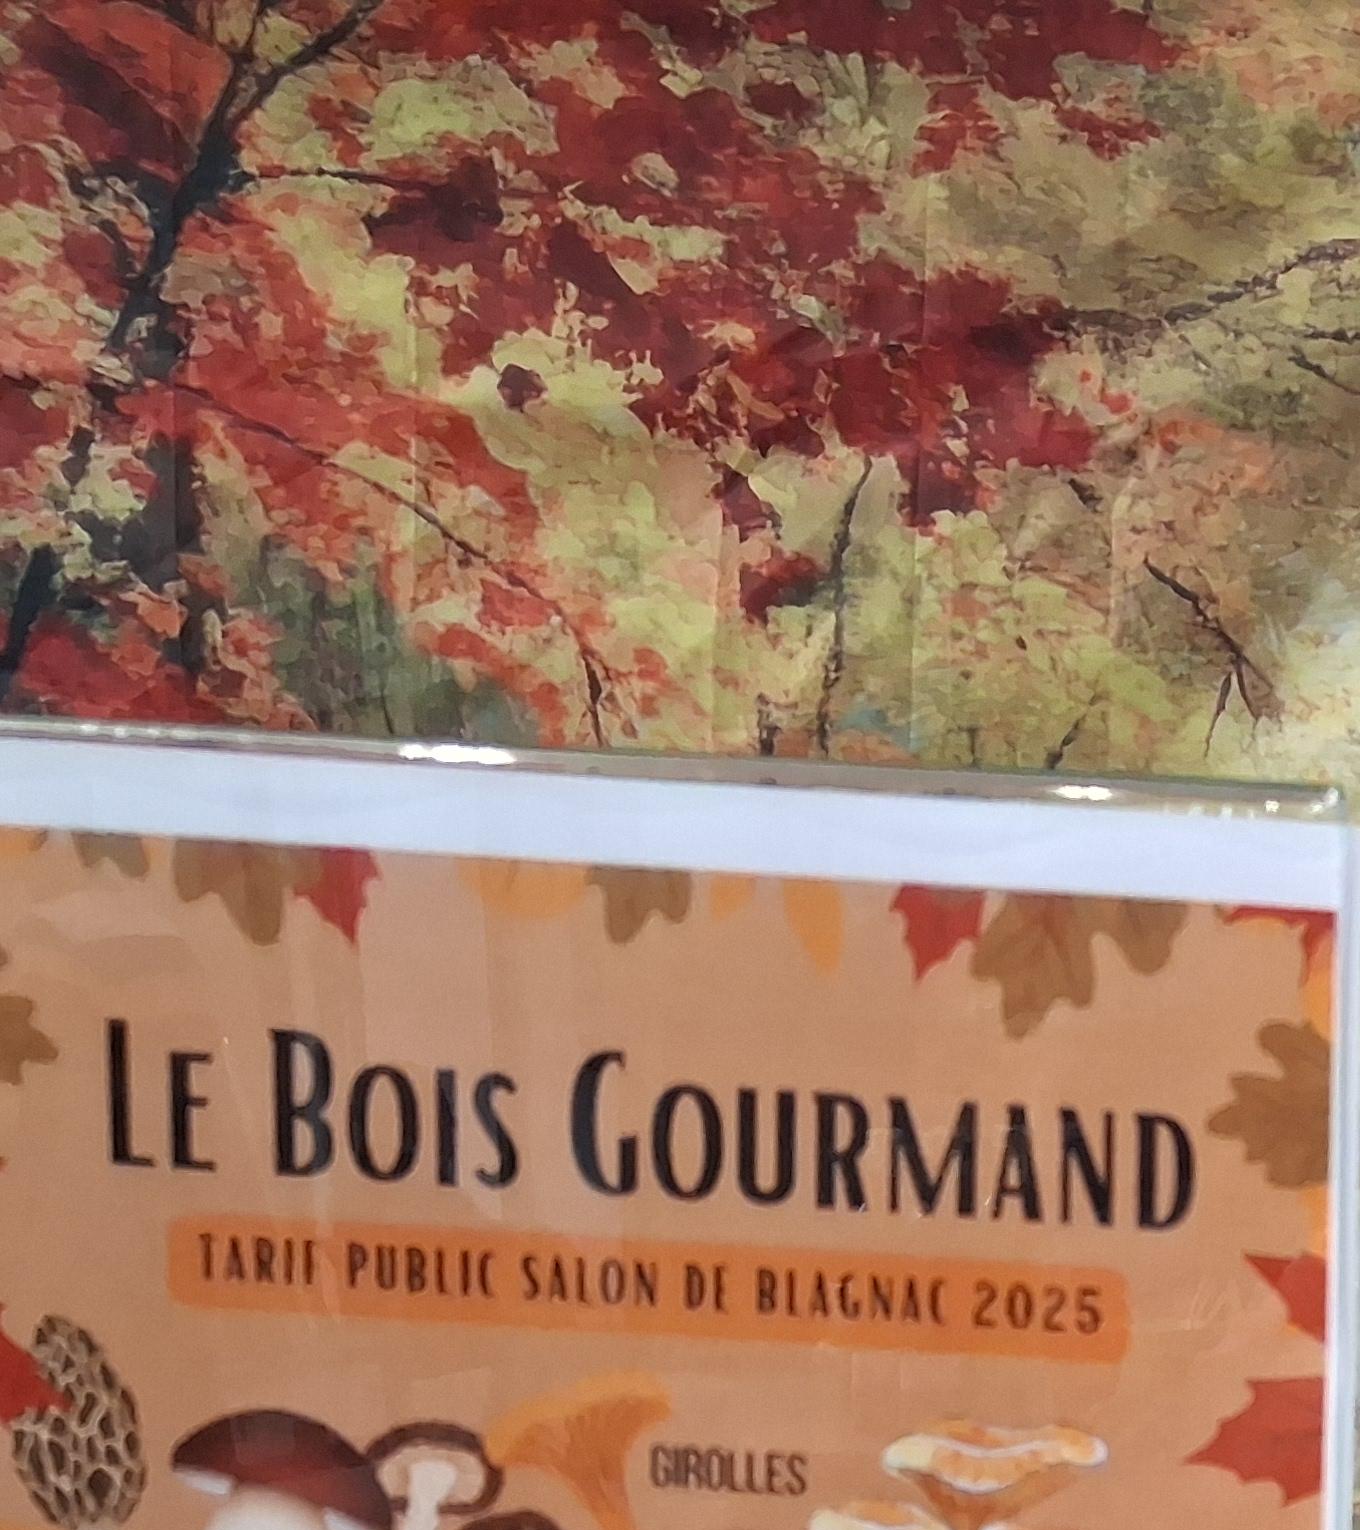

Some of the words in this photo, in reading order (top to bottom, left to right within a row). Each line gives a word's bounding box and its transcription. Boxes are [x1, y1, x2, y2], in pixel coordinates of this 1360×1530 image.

[108, 1018, 217, 1172] LE
[270, 1028, 519, 1189] BOIS
[570, 1050, 1196, 1231] GOURMAND
[199, 1233, 316, 1285] TARIF
[346, 1240, 495, 1299] PUBLIC
[520, 1252, 657, 1309] SALON
[684, 1264, 728, 1315] DE
[756, 1265, 945, 1326] BLAGNAC
[972, 1277, 1102, 1334] 2025
[650, 1444, 808, 1496] GIROLLES
